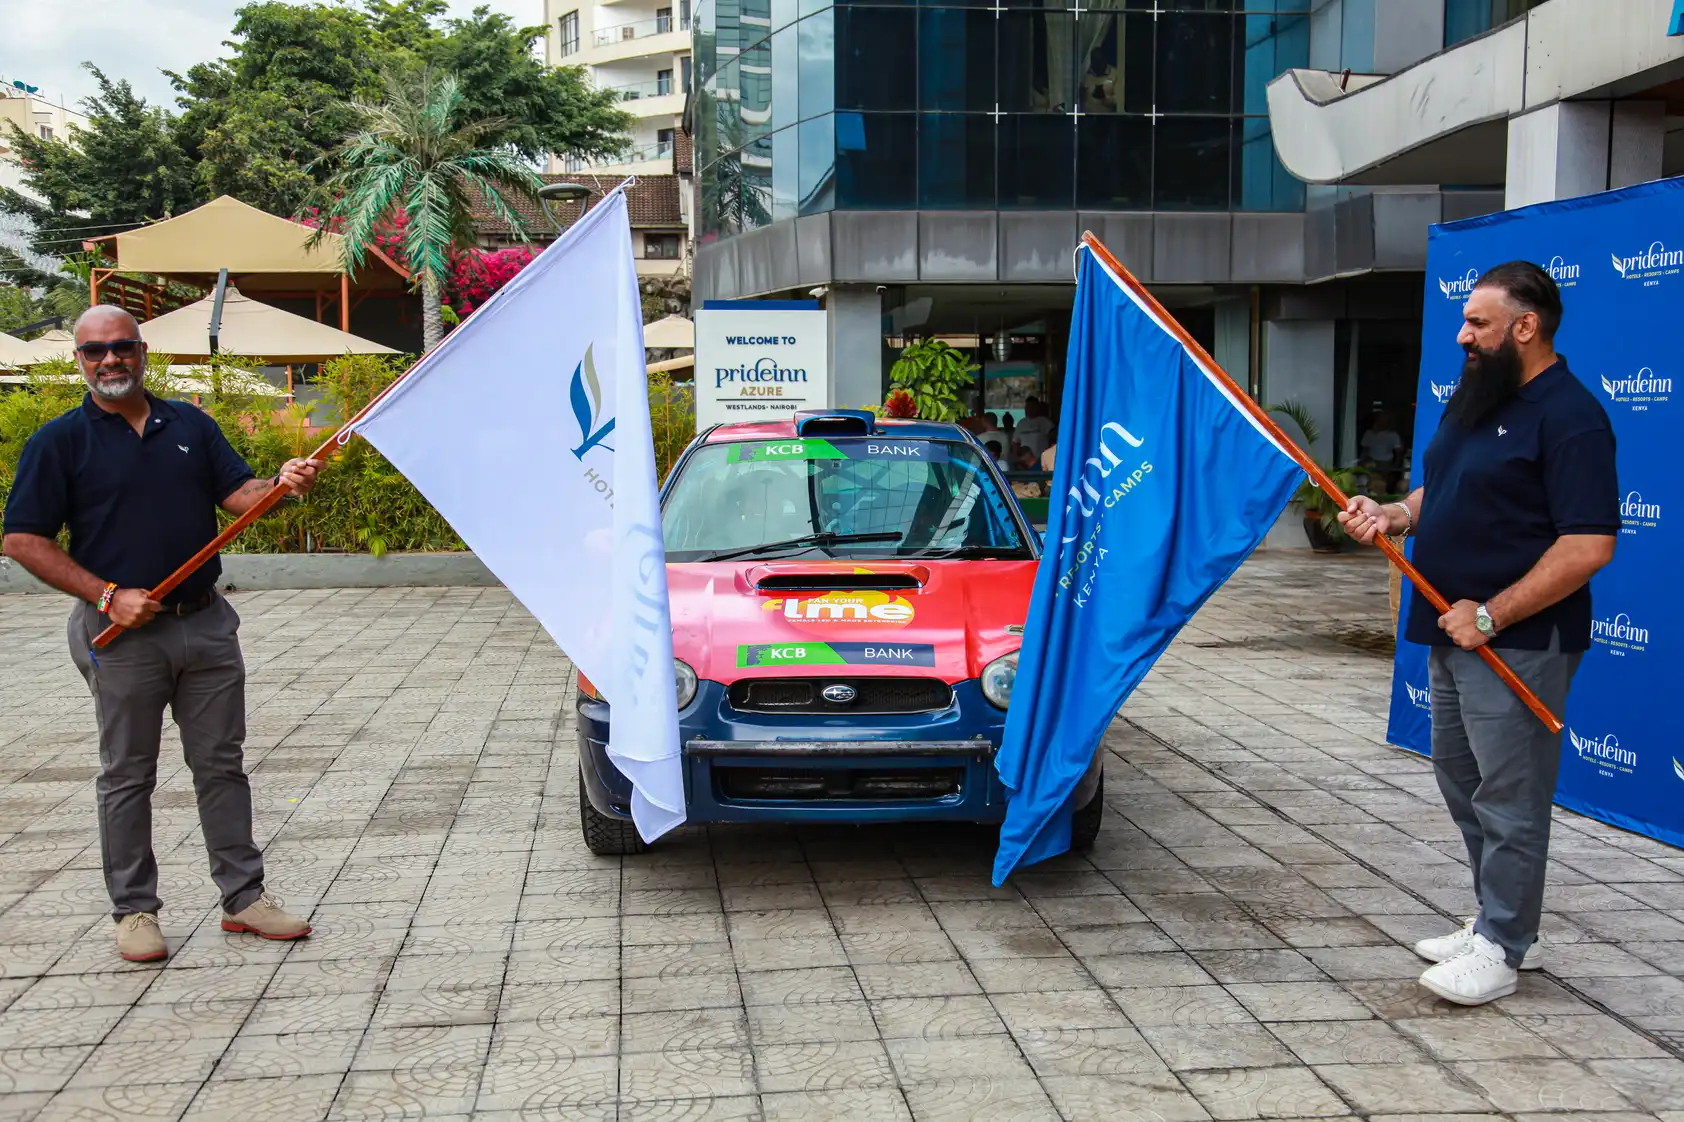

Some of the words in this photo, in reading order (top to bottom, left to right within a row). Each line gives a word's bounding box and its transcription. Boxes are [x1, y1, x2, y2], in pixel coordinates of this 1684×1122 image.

[1621, 241, 1683, 278] prideinn
[725, 336, 779, 345] WELCOME
[781, 336, 797, 345] TO
[715, 357, 808, 388] prideinn
[1611, 366, 1672, 400] prideinn
[740, 386, 783, 396] AZURE
[765, 445, 804, 455] KCB
[867, 444, 921, 456] BANK
[584, 467, 614, 510] HOT
[1104, 460, 1153, 508] CAMPS
[1073, 547, 1109, 608] KENYA
[1590, 613, 1648, 643] prideinn
[771, 648, 807, 659] KCB
[864, 647, 914, 659] BANK
[1579, 734, 1637, 767] prideinn
[1598, 769, 1614, 777] KENYA
